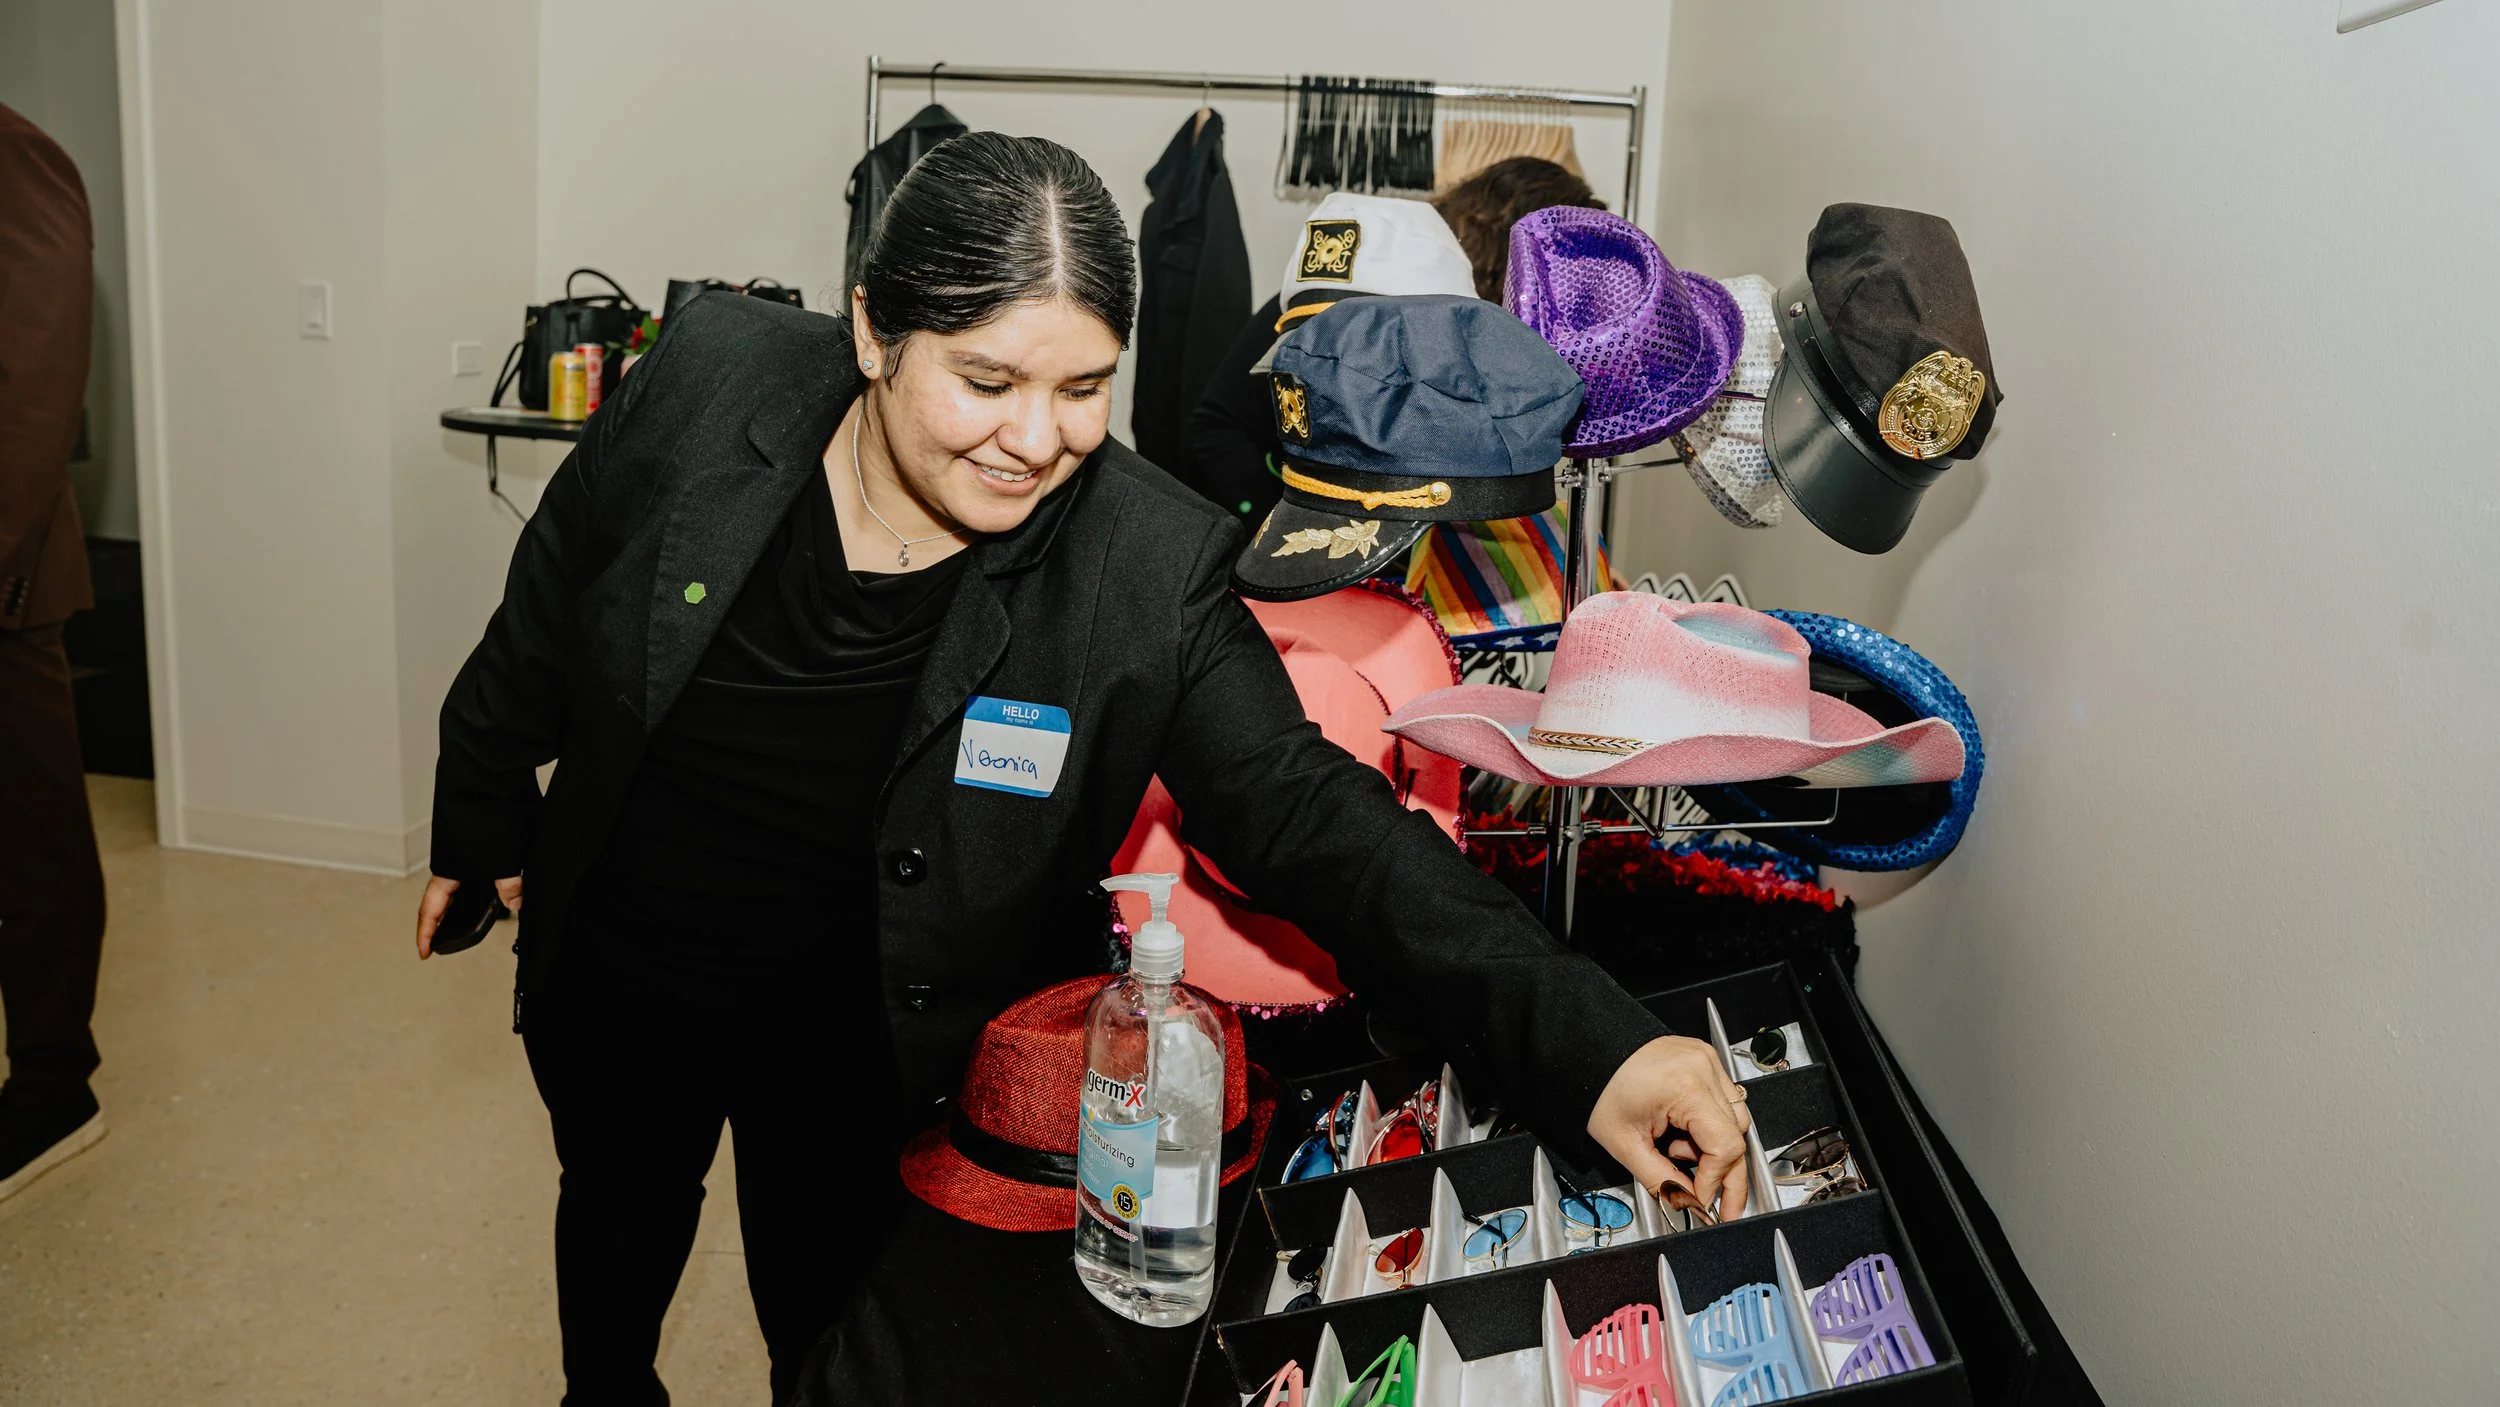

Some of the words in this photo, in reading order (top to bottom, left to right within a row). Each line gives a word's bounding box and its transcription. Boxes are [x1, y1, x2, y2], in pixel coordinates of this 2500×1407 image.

[1901, 418, 1932, 441] POLICE
[1002, 704, 1040, 720] HELLO
[1005, 716, 1014, 724] my
[1087, 1070, 1144, 1108] germ-X
[1083, 1121, 1135, 1168] moisturizing
[1113, 1201, 1138, 1219] SECONDS
[1120, 1193, 1131, 1210] 15
